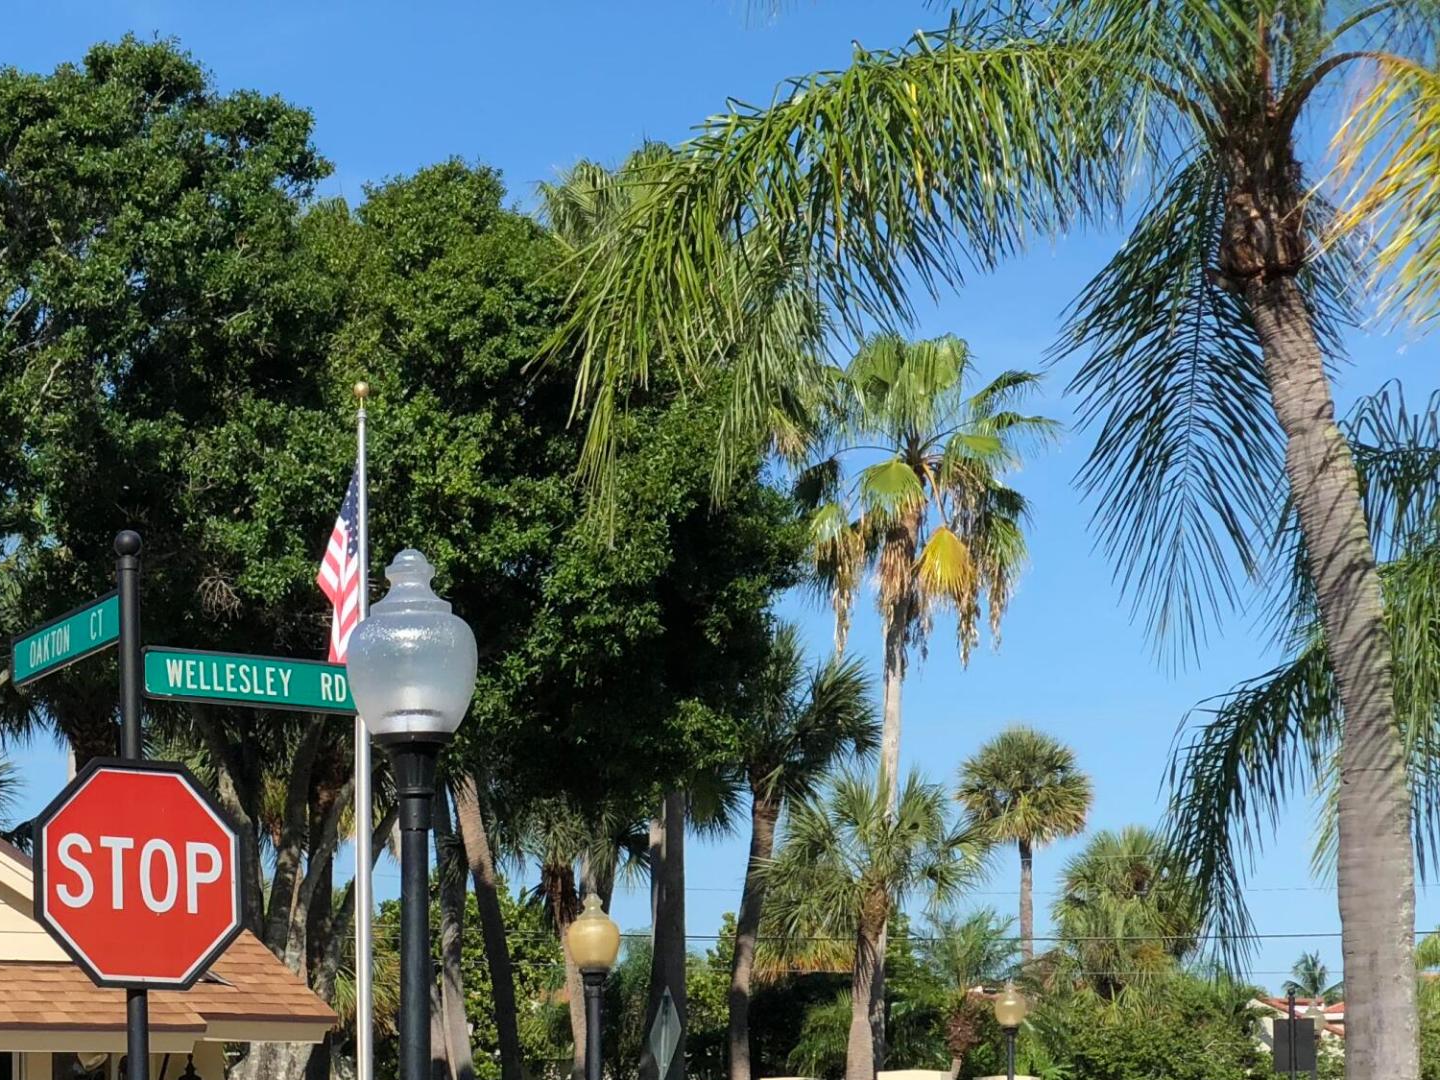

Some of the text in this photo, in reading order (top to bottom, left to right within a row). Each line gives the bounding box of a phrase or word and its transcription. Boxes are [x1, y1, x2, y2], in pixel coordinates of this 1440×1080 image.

[30, 608, 103, 668] OAKTON CT
[166, 658, 347, 702] WELLESLEY RD
[56, 832, 223, 914] STOP
